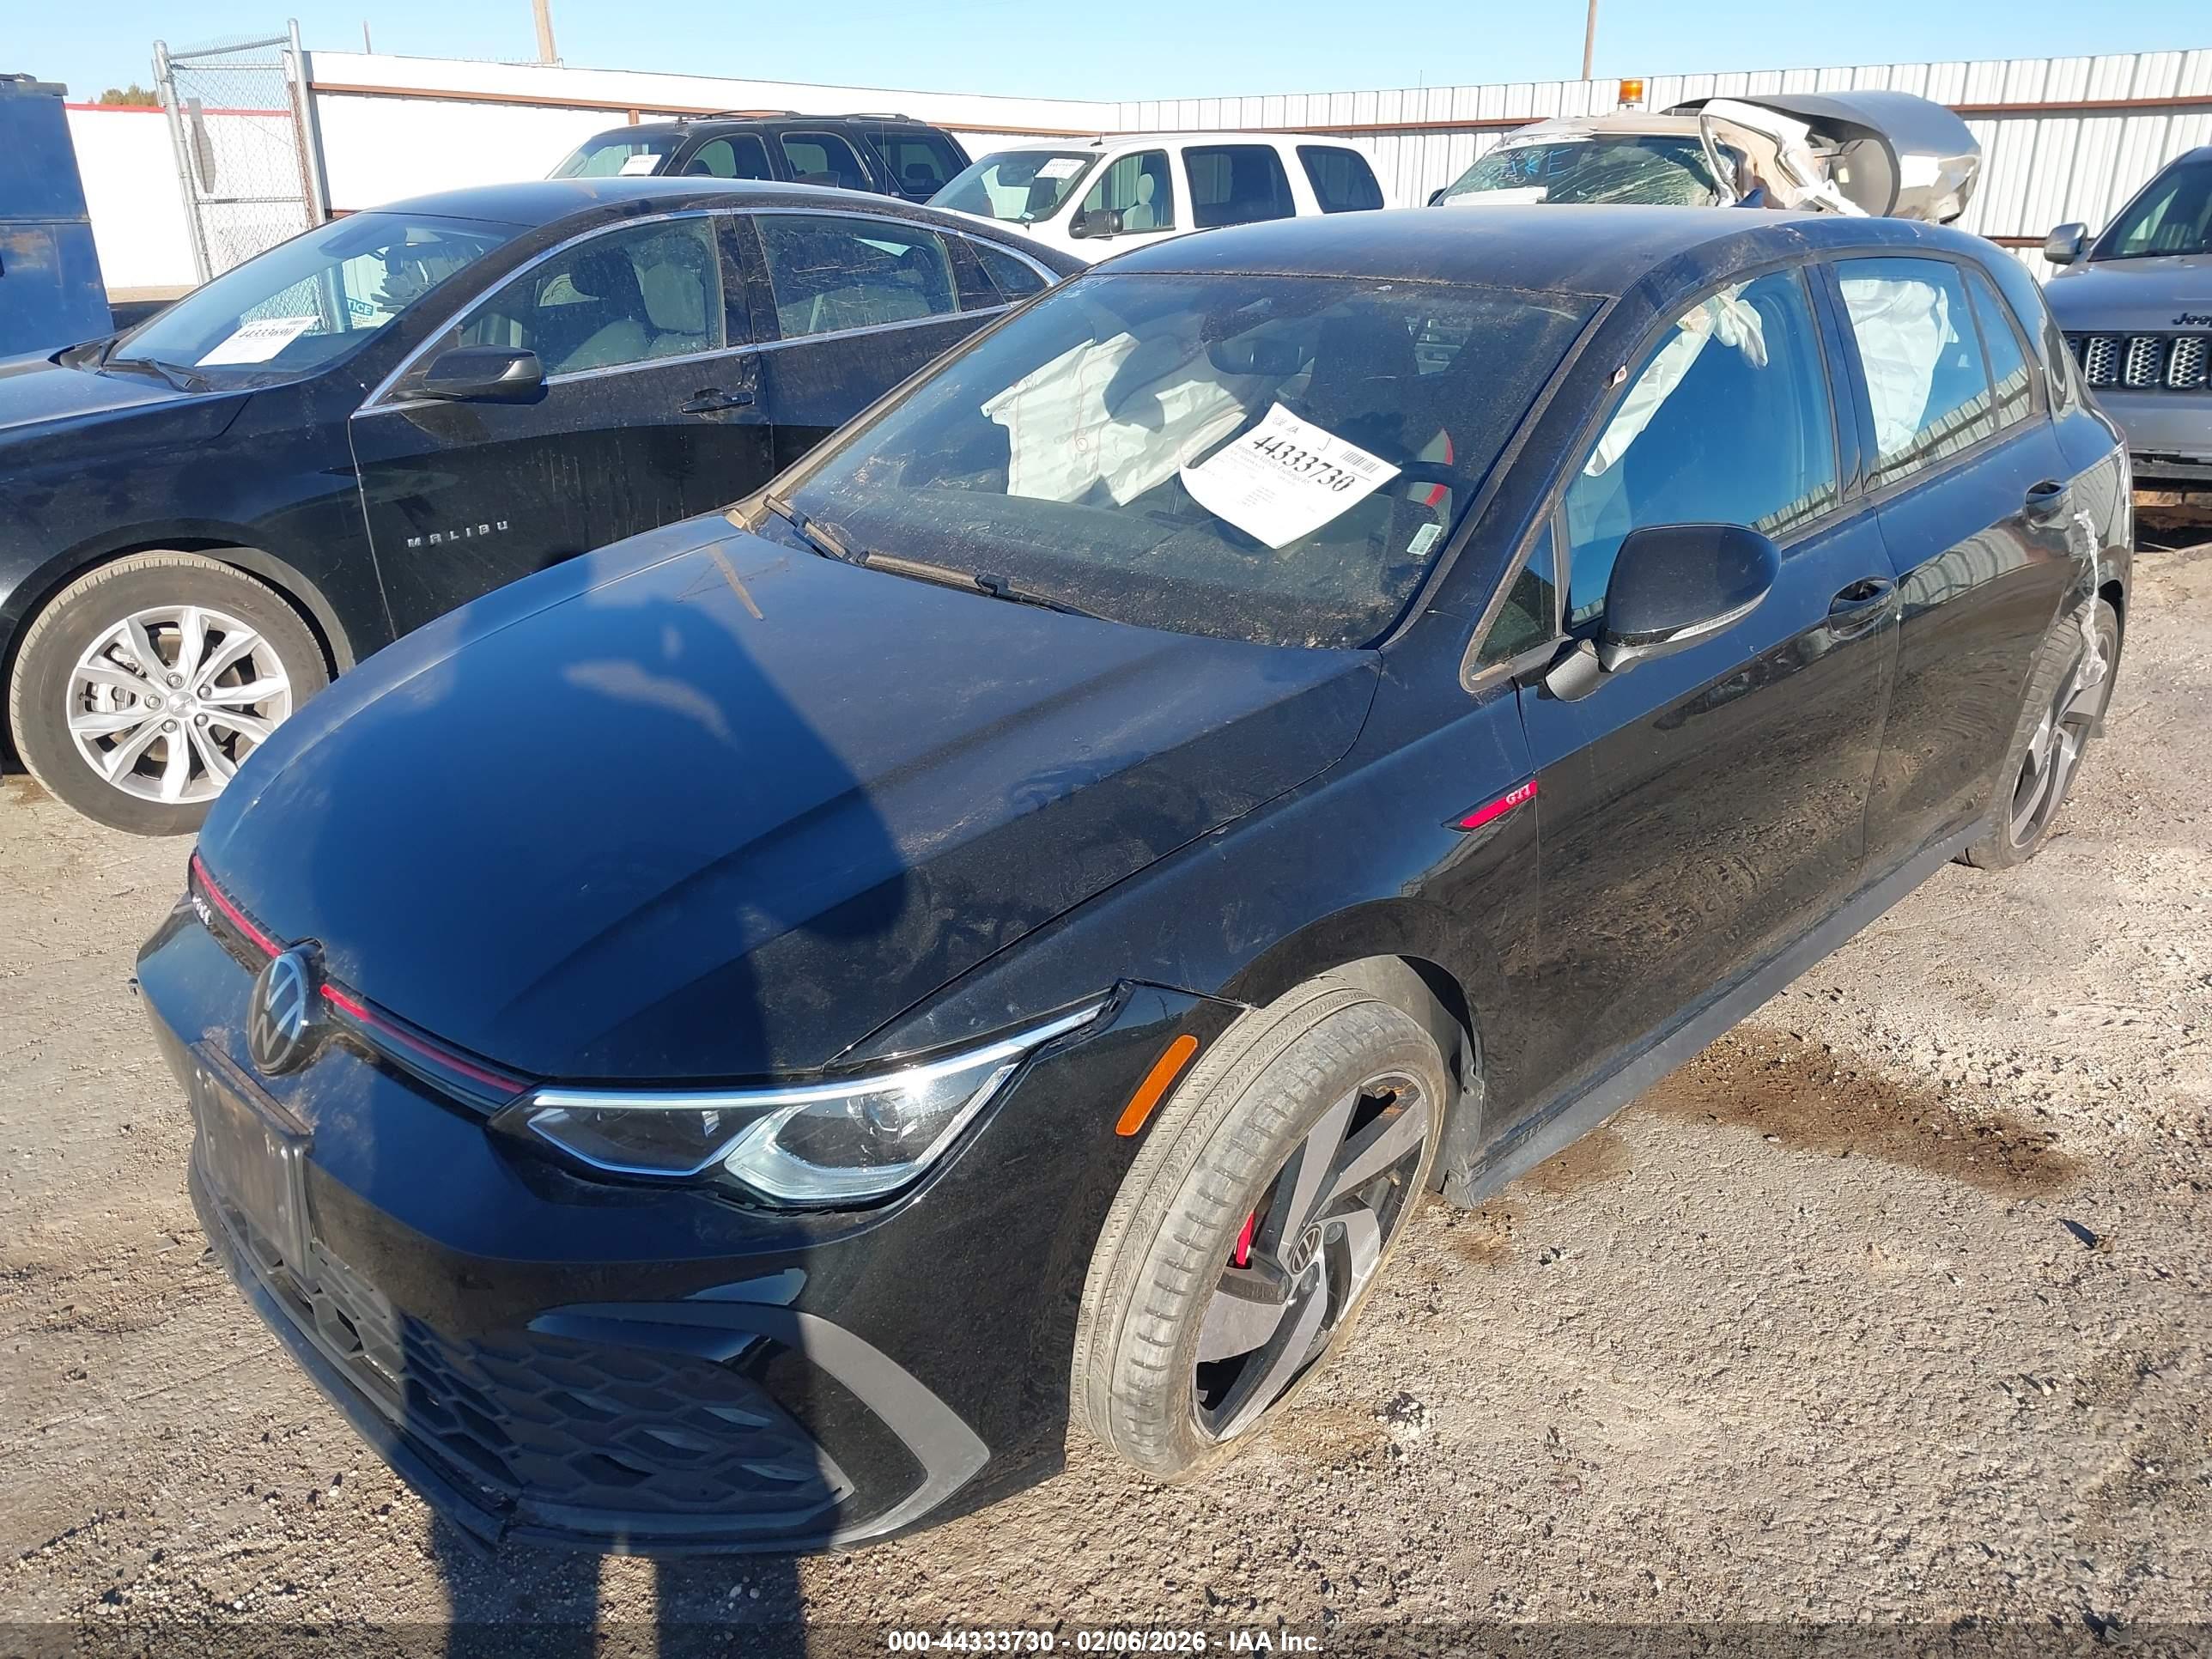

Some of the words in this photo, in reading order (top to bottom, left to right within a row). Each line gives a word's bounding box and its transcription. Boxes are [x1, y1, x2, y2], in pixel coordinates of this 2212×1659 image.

[346, 299, 373, 315] TICE
[1253, 435, 1355, 491] 44333730
[407, 520, 508, 548] MALIBU
[1505, 785, 1531, 805] GTI
